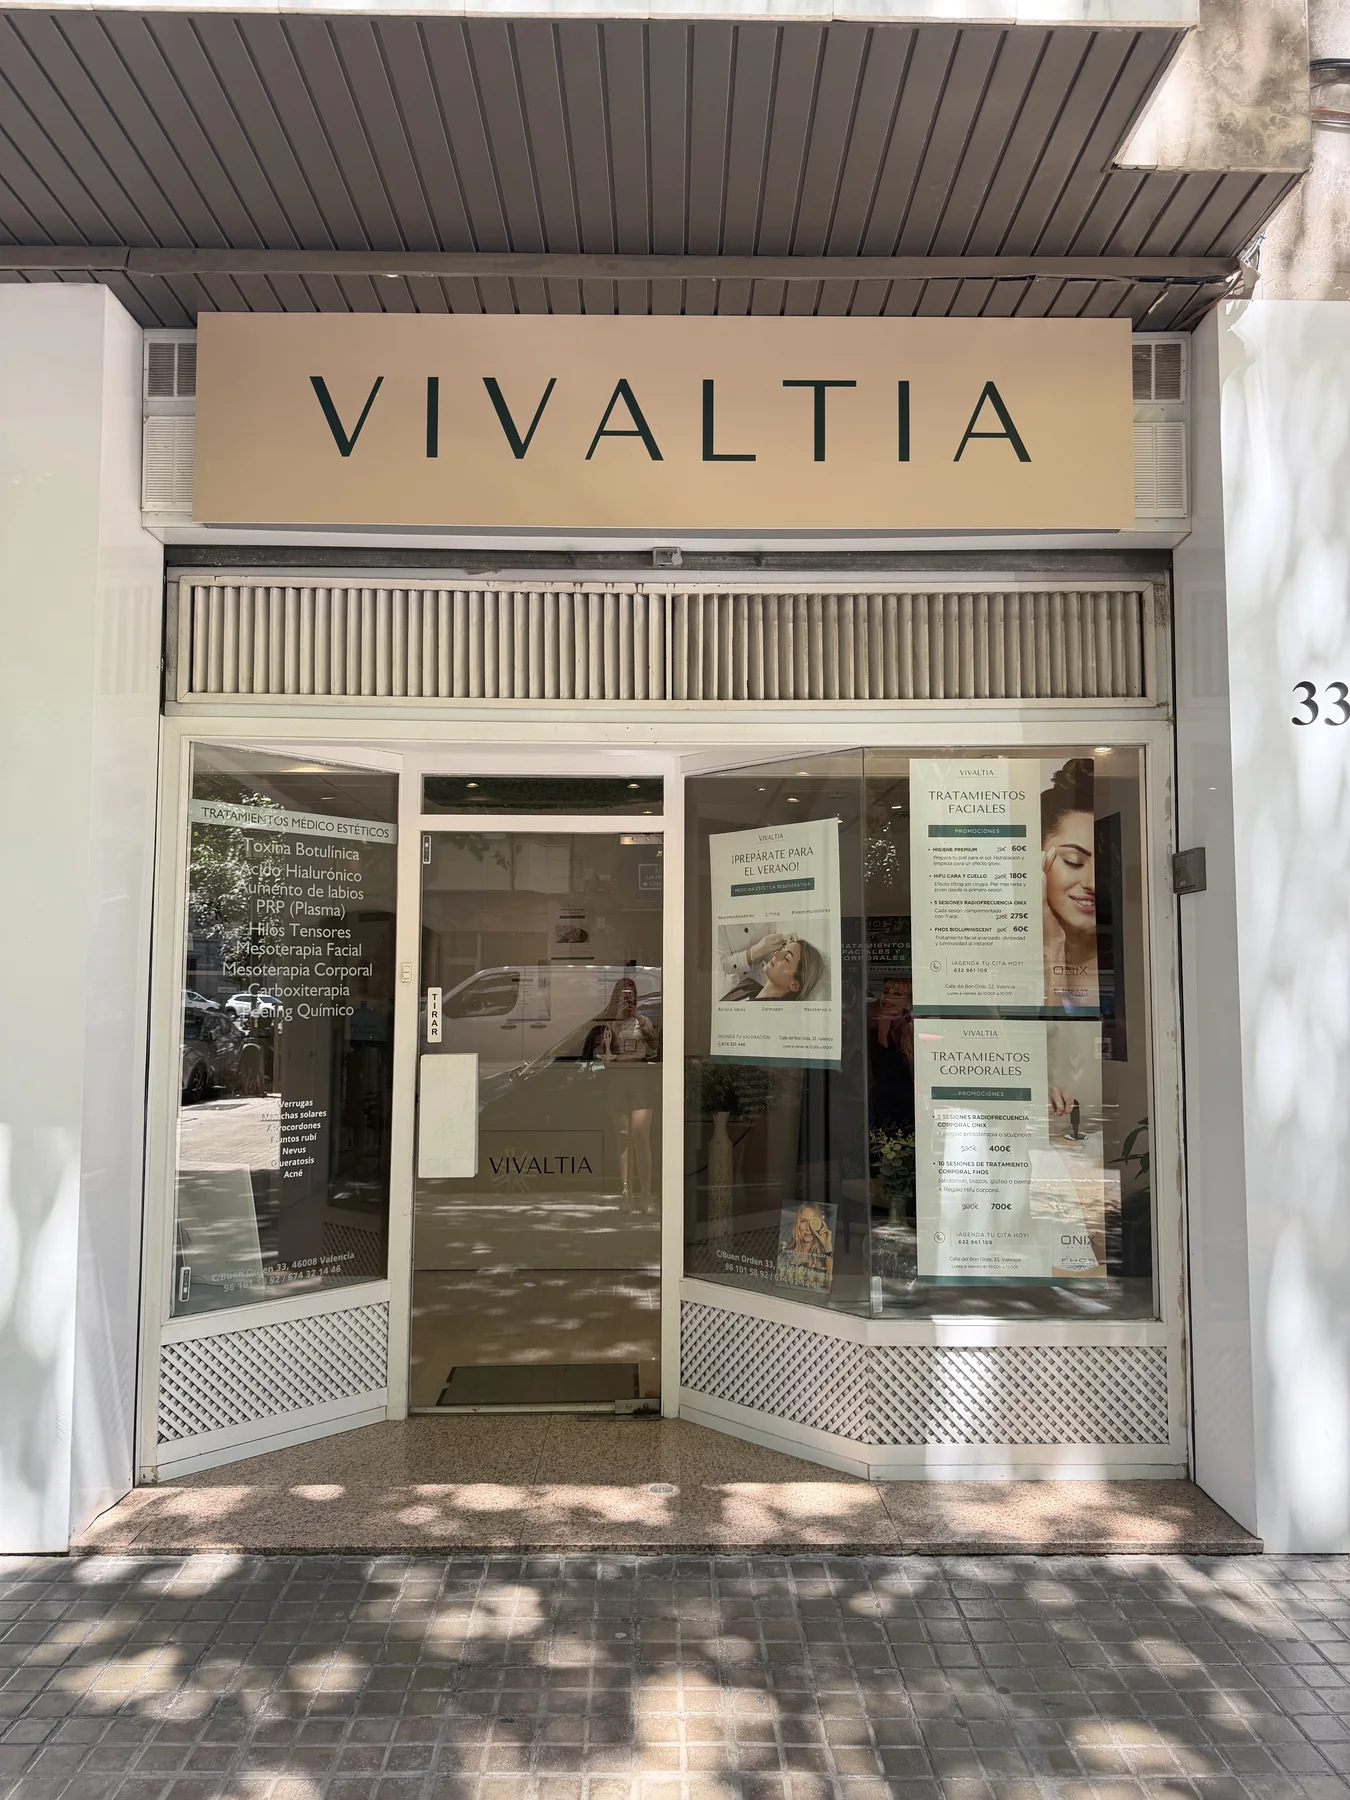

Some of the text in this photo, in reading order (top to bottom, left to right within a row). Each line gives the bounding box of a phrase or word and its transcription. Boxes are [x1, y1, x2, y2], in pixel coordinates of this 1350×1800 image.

[309, 376, 1032, 462] VIVALTIA
[1292, 681, 1350, 725] 33
[928, 791, 1025, 800] TRATAMIENTOS
[948, 804, 1006, 813] FACIALES
[202, 807, 389, 838] TRATAMIENTOS MÉDICO ESTÉTICOS
[759, 833, 783, 841] VIVALTIA
[243, 837, 359, 860] Toxina Botulínica
[731, 847, 814, 864] ¡PREPÁRATE PARA
[287, 864, 362, 882] Hialurónico
[744, 862, 799, 876] EL VERANO!
[238, 882, 364, 900] Aumento de labios
[257, 900, 345, 920] PRP (Plasma)
[249, 922, 351, 938] Hilos Tensores
[236, 941, 362, 959] Mesoterapia Facial
[223, 962, 372, 979] Mesoterapia Corporal
[248, 983, 350, 1000] Carboxiterapia
[297, 1003, 354, 1019] Químico
[931, 1052, 1030, 1063] TRATAMIENTOS
[940, 1066, 1021, 1076] CORPORALES
[277, 1100, 313, 1108] Verrugas
[301, 1133, 317, 1141] rubí
[284, 1169, 303, 1178] Acné
[489, 1157, 592, 1174] VIVALTIA
[1061, 1235, 1095, 1245] ONIX
[276, 1263, 289, 1271] 33,
[292, 1258, 317, 1269] 46008
[320, 1252, 355, 1264] Valencia
[716, 1250, 739, 1261] C/Buen
[742, 1255, 763, 1266] Orden
[224, 1284, 234, 1292] 96
[270, 1275, 280, 1284] 92
[288, 1272, 303, 1281] 674
[306, 1269, 315, 1278] 32
[319, 1267, 328, 1276] 14
[331, 1265, 341, 1273] 46
[725, 1263, 733, 1271] 96
[736, 1265, 747, 1274] 101
[750, 1268, 758, 1276] 58
[760, 1271, 768, 1279] 92
